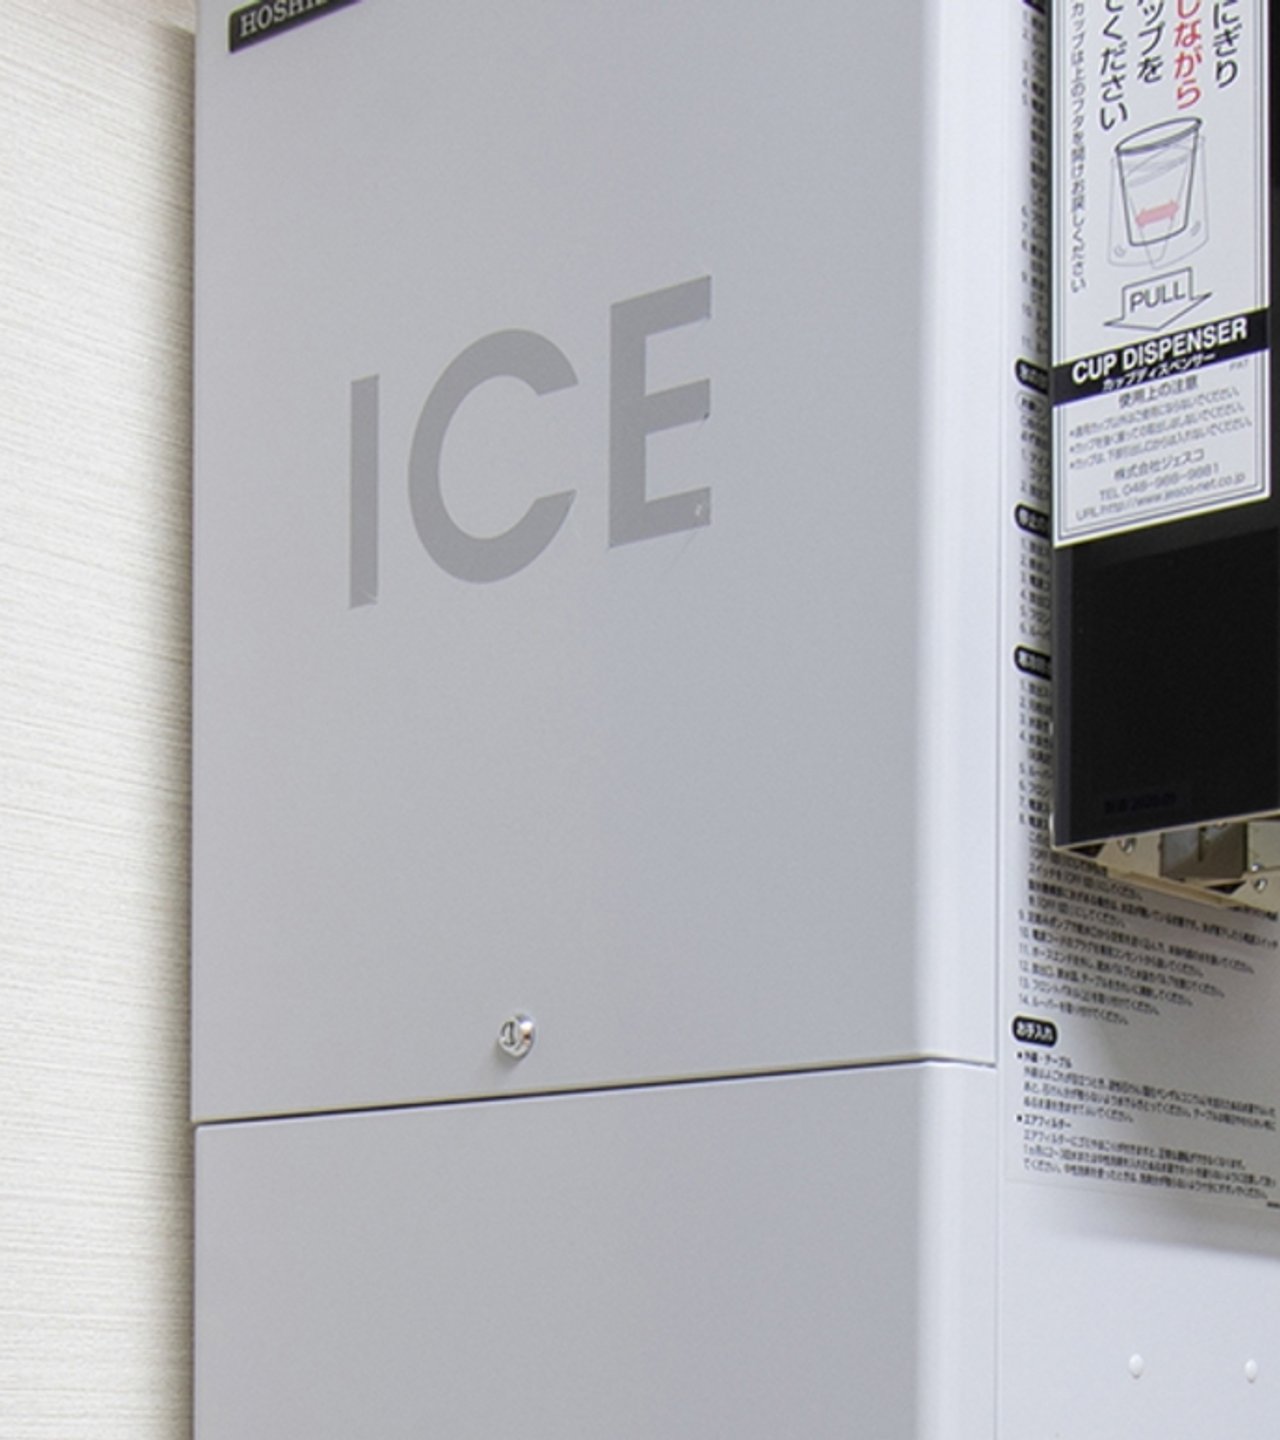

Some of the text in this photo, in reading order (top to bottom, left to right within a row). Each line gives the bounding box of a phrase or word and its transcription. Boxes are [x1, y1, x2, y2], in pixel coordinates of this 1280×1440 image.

[240, 0, 328, 37] HOSH
[1137, 0, 1164, 83] ップを
[1213, 0, 1241, 88] にぎり
[1129, 281, 1186, 313] PULL
[1072, 352, 1117, 384] CUP
[1122, 317, 1248, 371] DISPENSER
[349, 275, 712, 609] ICE
